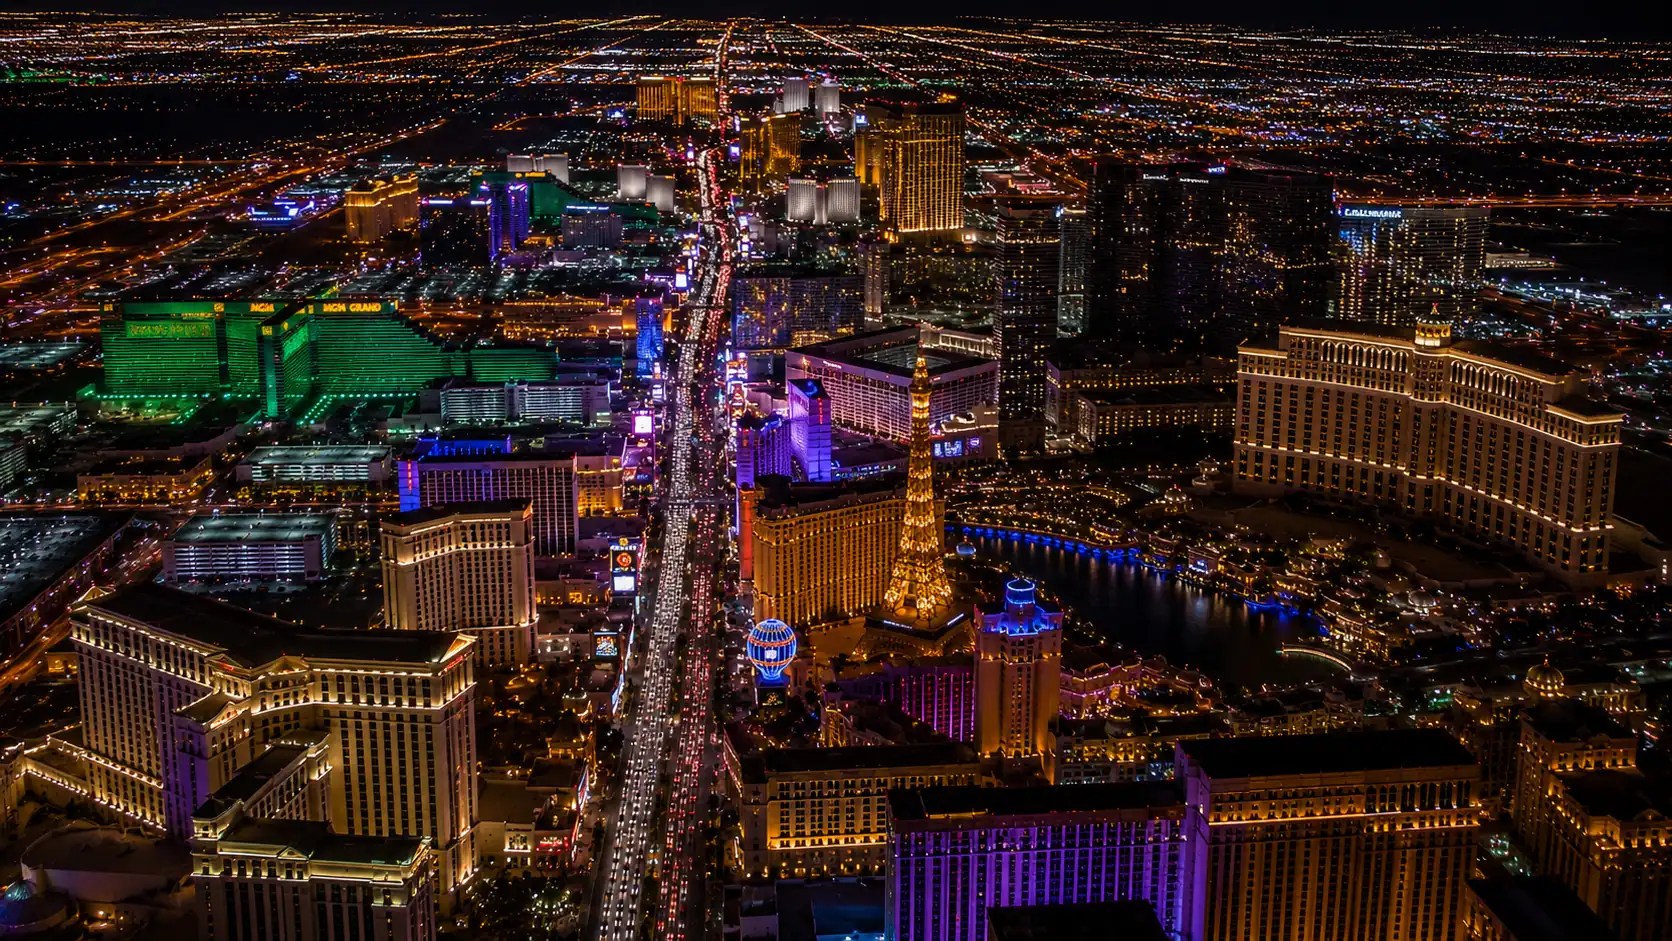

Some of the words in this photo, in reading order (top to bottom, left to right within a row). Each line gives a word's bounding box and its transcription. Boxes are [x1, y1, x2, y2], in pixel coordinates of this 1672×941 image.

[250, 303, 274, 312] MGM
[323, 303, 346, 312] MGM
[350, 303, 381, 312] GRAND
